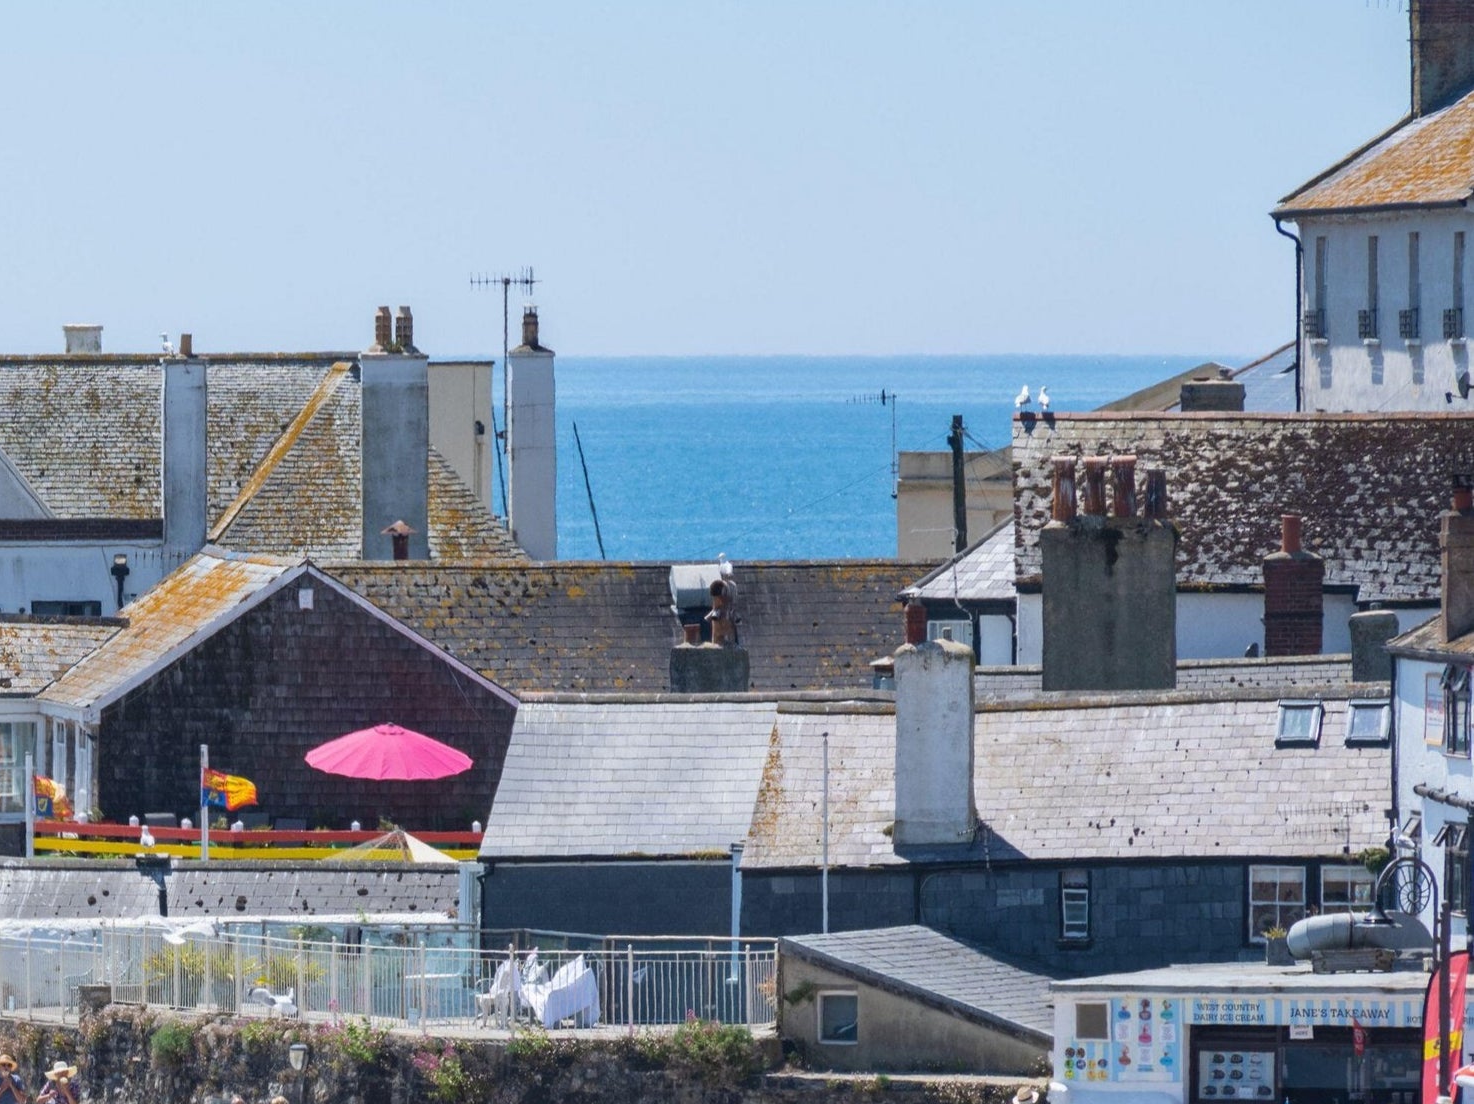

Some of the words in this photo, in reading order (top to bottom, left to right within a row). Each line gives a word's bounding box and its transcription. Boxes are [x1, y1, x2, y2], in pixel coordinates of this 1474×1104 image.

[1197, 1003, 1219, 1011] WEST
[1221, 1003, 1260, 1011] COUNTRY
[1193, 1013, 1218, 1021] DAIRY
[1235, 1014, 1264, 1022] CREAM
[1290, 1008, 1327, 1018] JANE'S
[1330, 1008, 1390, 1019] TAKEAWAY
